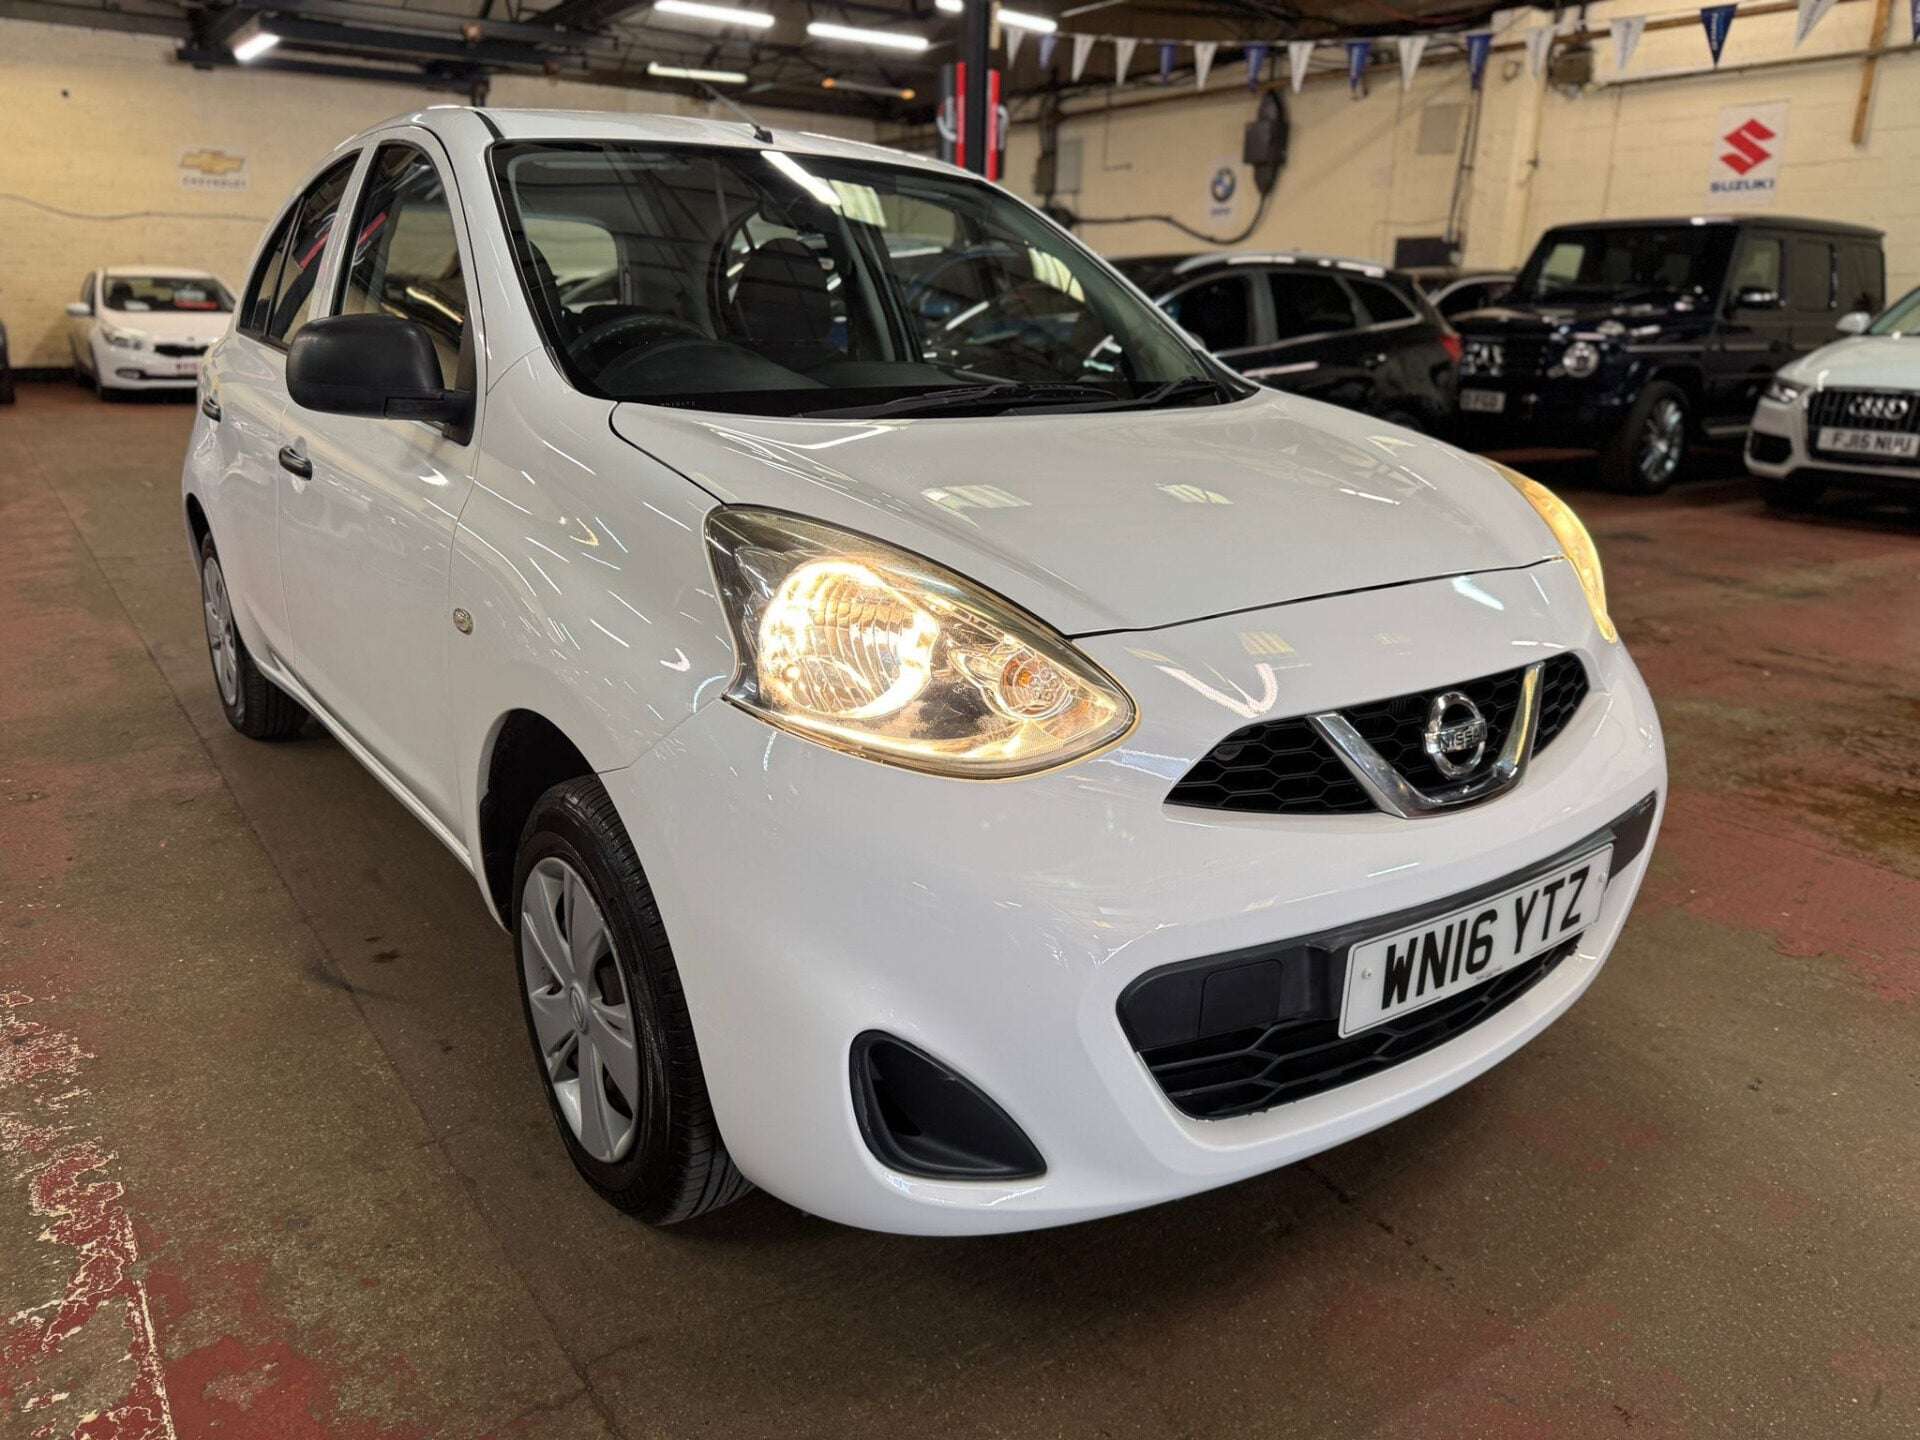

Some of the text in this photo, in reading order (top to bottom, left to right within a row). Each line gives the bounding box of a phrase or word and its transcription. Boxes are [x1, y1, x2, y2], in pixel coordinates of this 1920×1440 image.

[1711, 178, 1775, 192] SUZUKI
[1441, 722, 1486, 752] NISSAN
[1381, 865, 1590, 1010] WN16 YTZ
